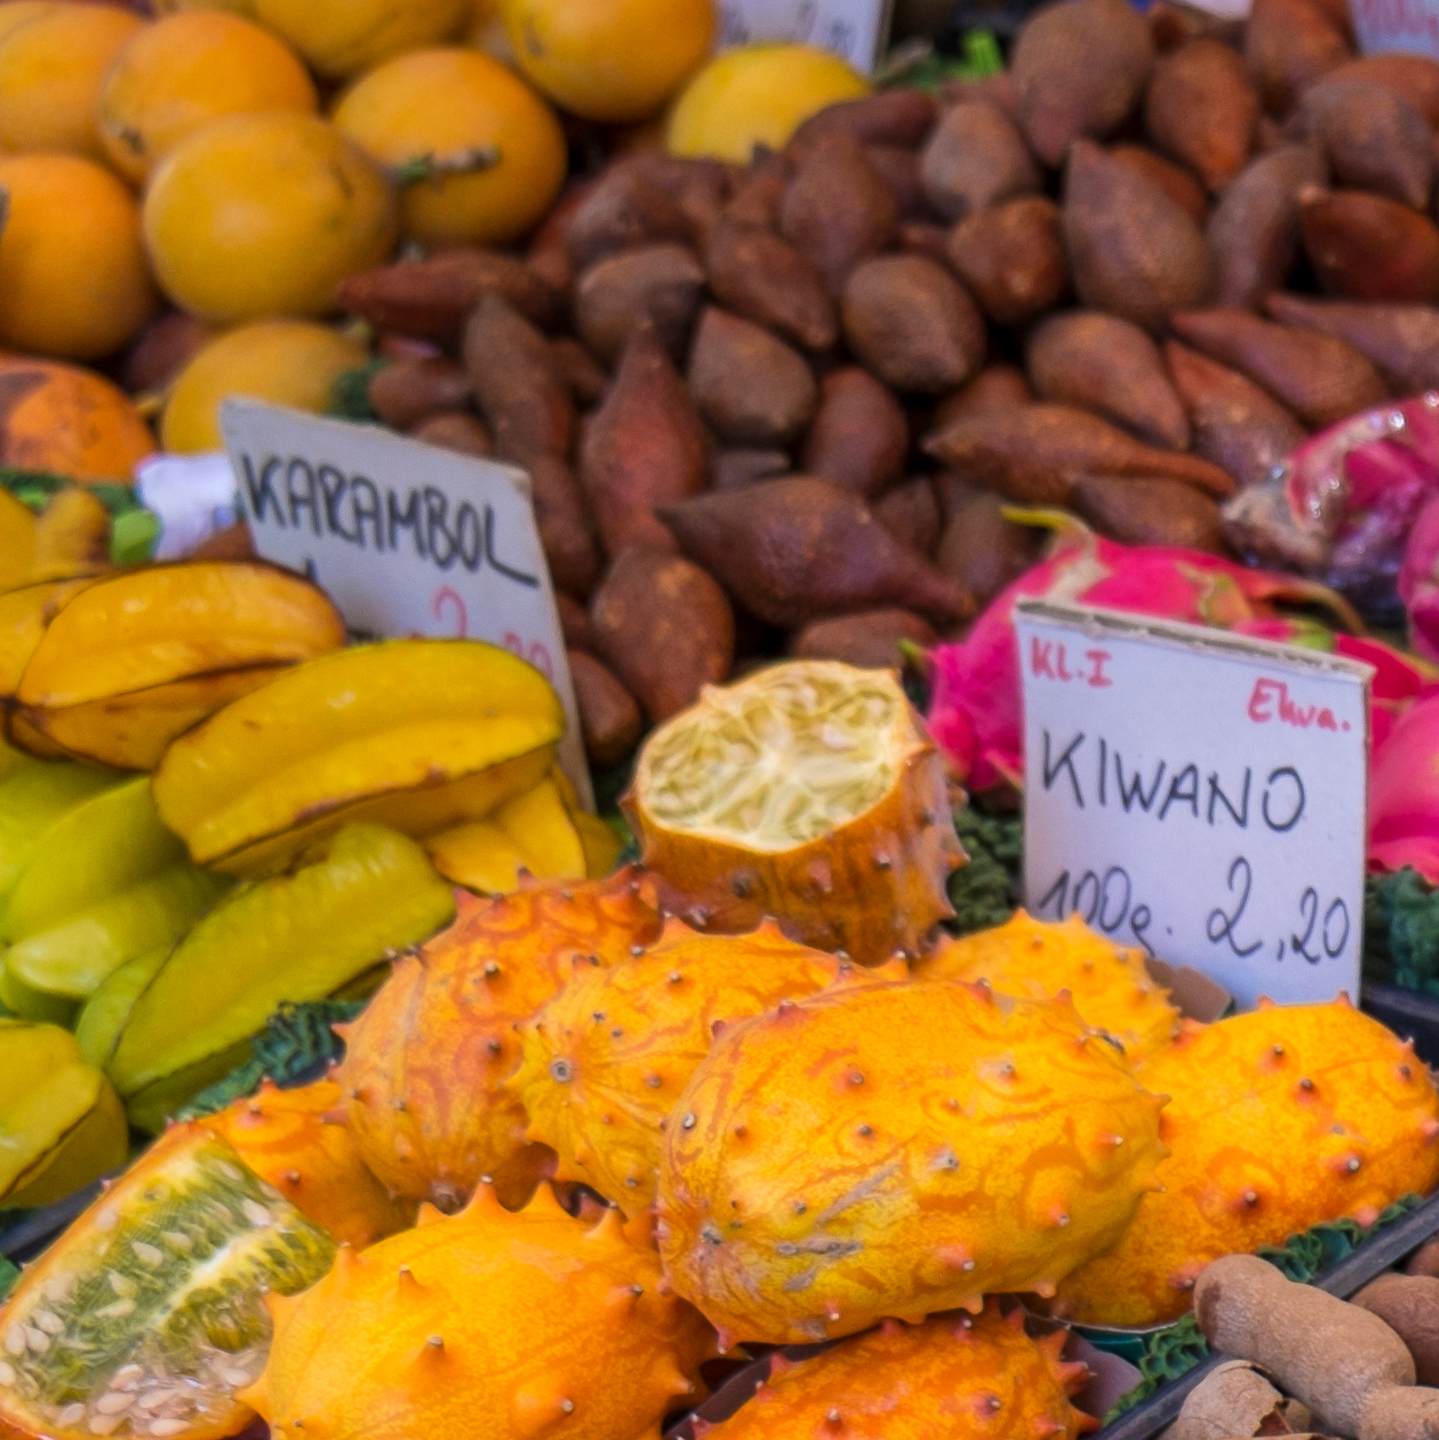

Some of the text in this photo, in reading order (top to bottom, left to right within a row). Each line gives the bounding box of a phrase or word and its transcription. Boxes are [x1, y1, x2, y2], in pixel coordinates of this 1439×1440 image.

[242, 453, 539, 589] KARAMBOL
[1040, 728, 1305, 833] KIWANO
[1206, 855, 1350, 964] 2,20
